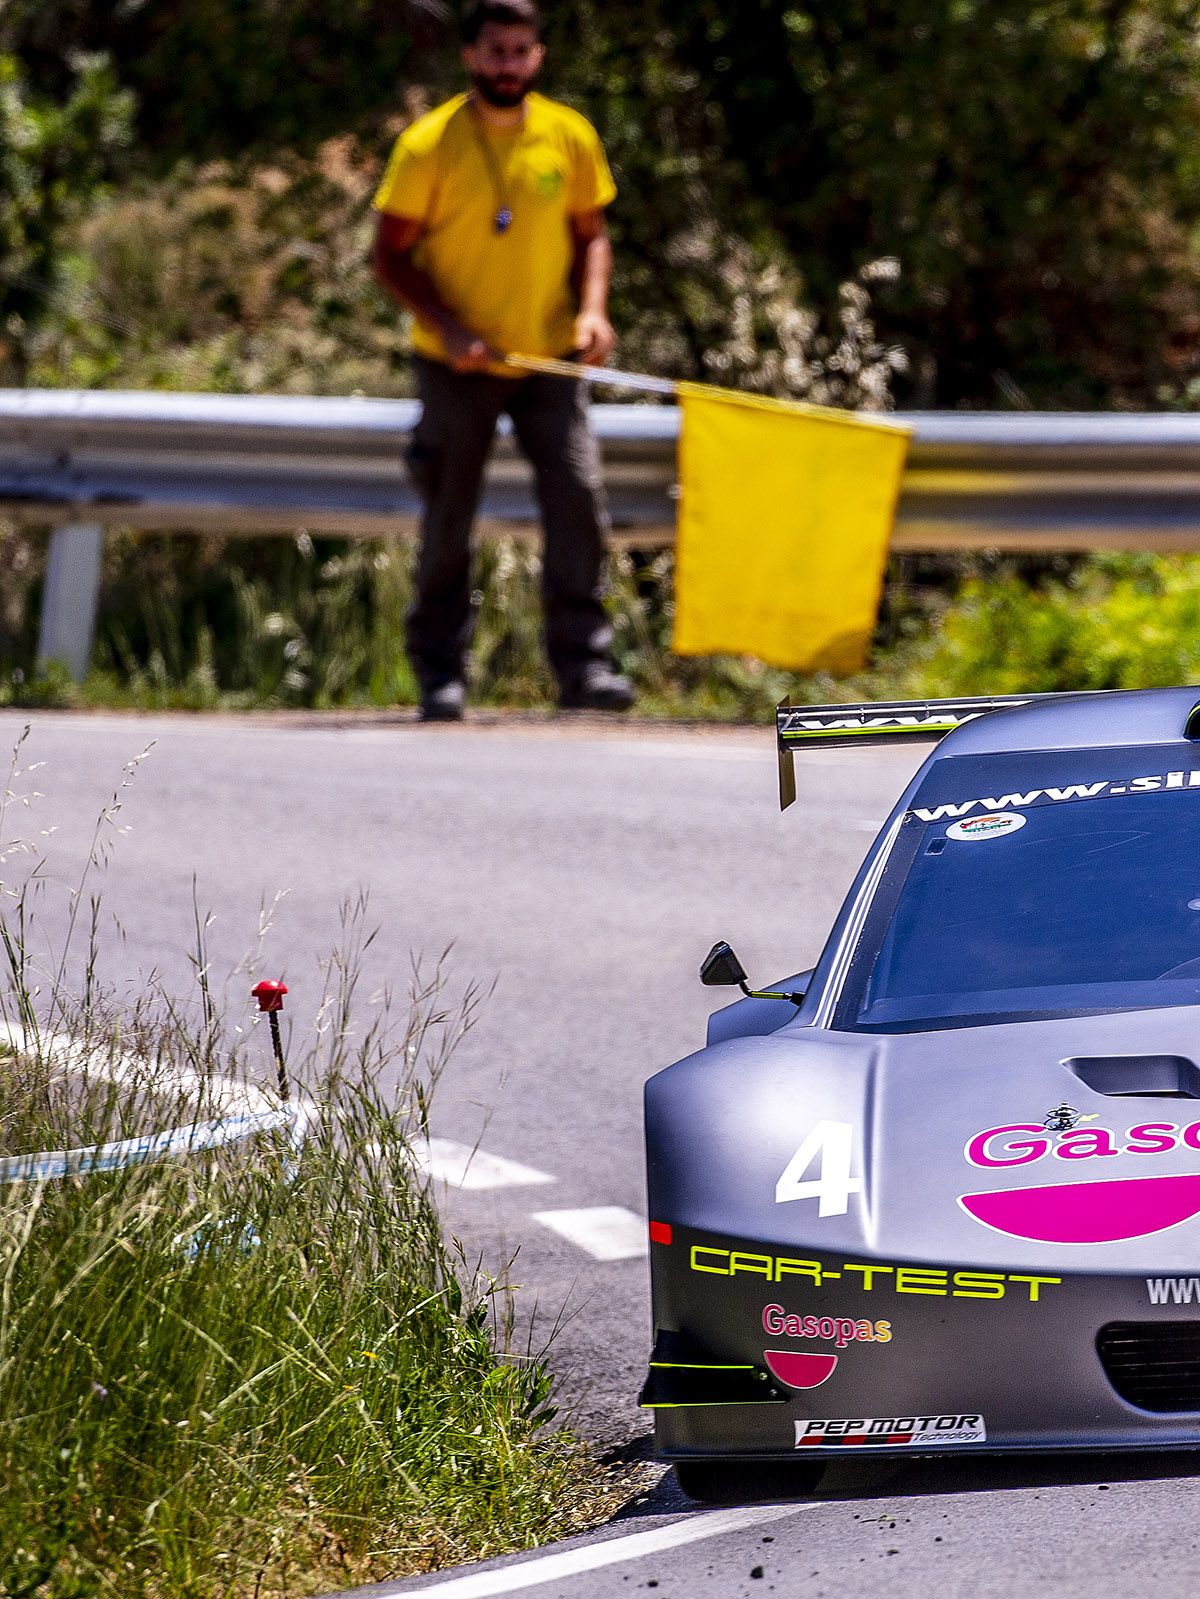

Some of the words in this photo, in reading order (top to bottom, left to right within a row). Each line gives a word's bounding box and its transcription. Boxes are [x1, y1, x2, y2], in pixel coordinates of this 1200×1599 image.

[775, 1120, 861, 1217] 4
[690, 1246, 1061, 1302] CAR-TEST
[762, 1303, 892, 1348] Gasopas
[804, 1420, 865, 1435] PEP
[867, 1415, 980, 1434] MOTOR
[913, 1431, 982, 1442] Technology
